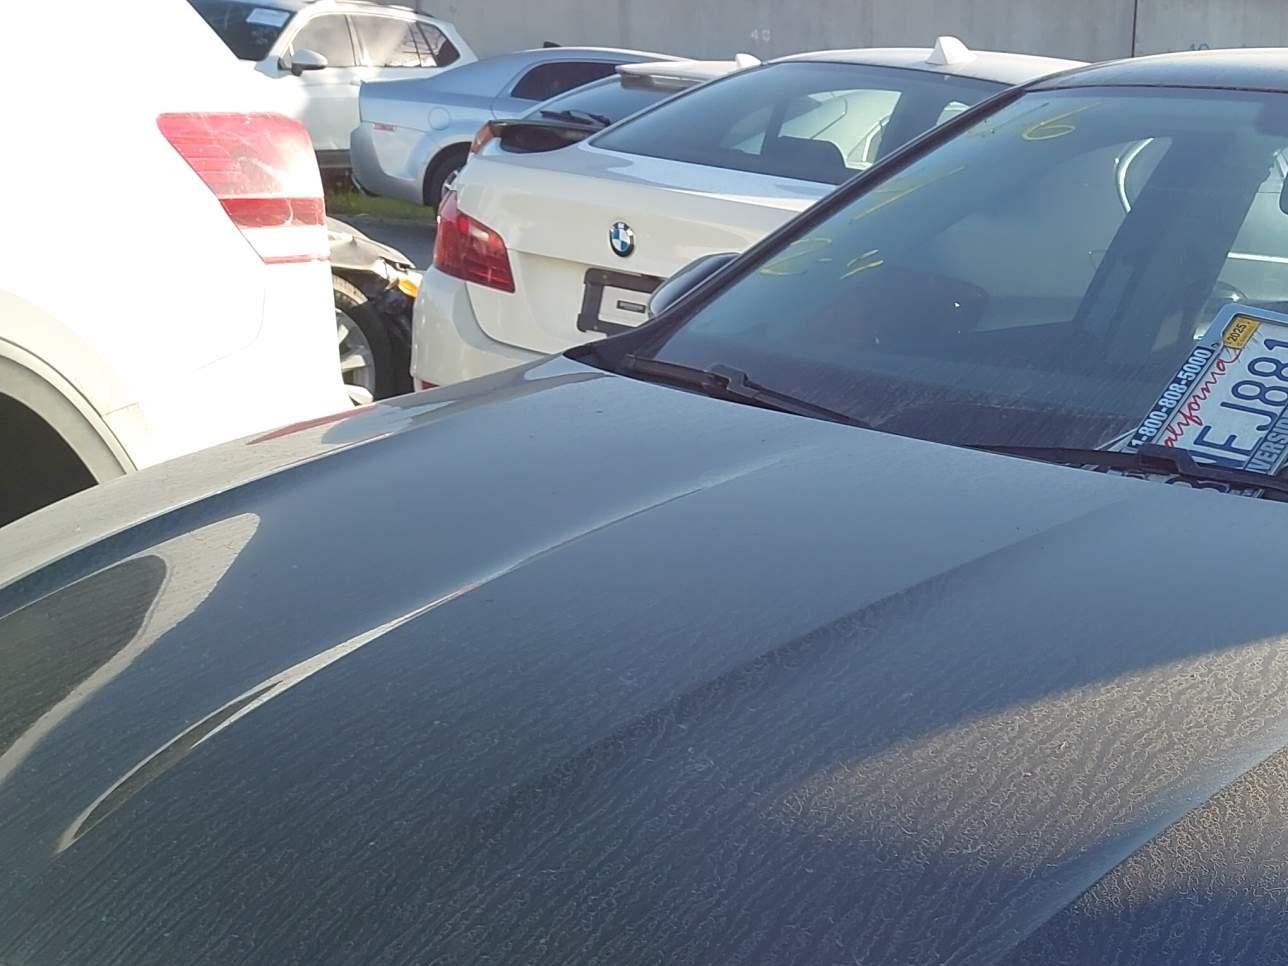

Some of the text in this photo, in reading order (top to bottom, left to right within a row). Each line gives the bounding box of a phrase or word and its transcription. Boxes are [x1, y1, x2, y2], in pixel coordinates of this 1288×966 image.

[1228, 323, 1248, 343] 2025
[1131, 348, 1210, 447] 1-800-808-5000
[1164, 350, 1241, 448] alifornia
